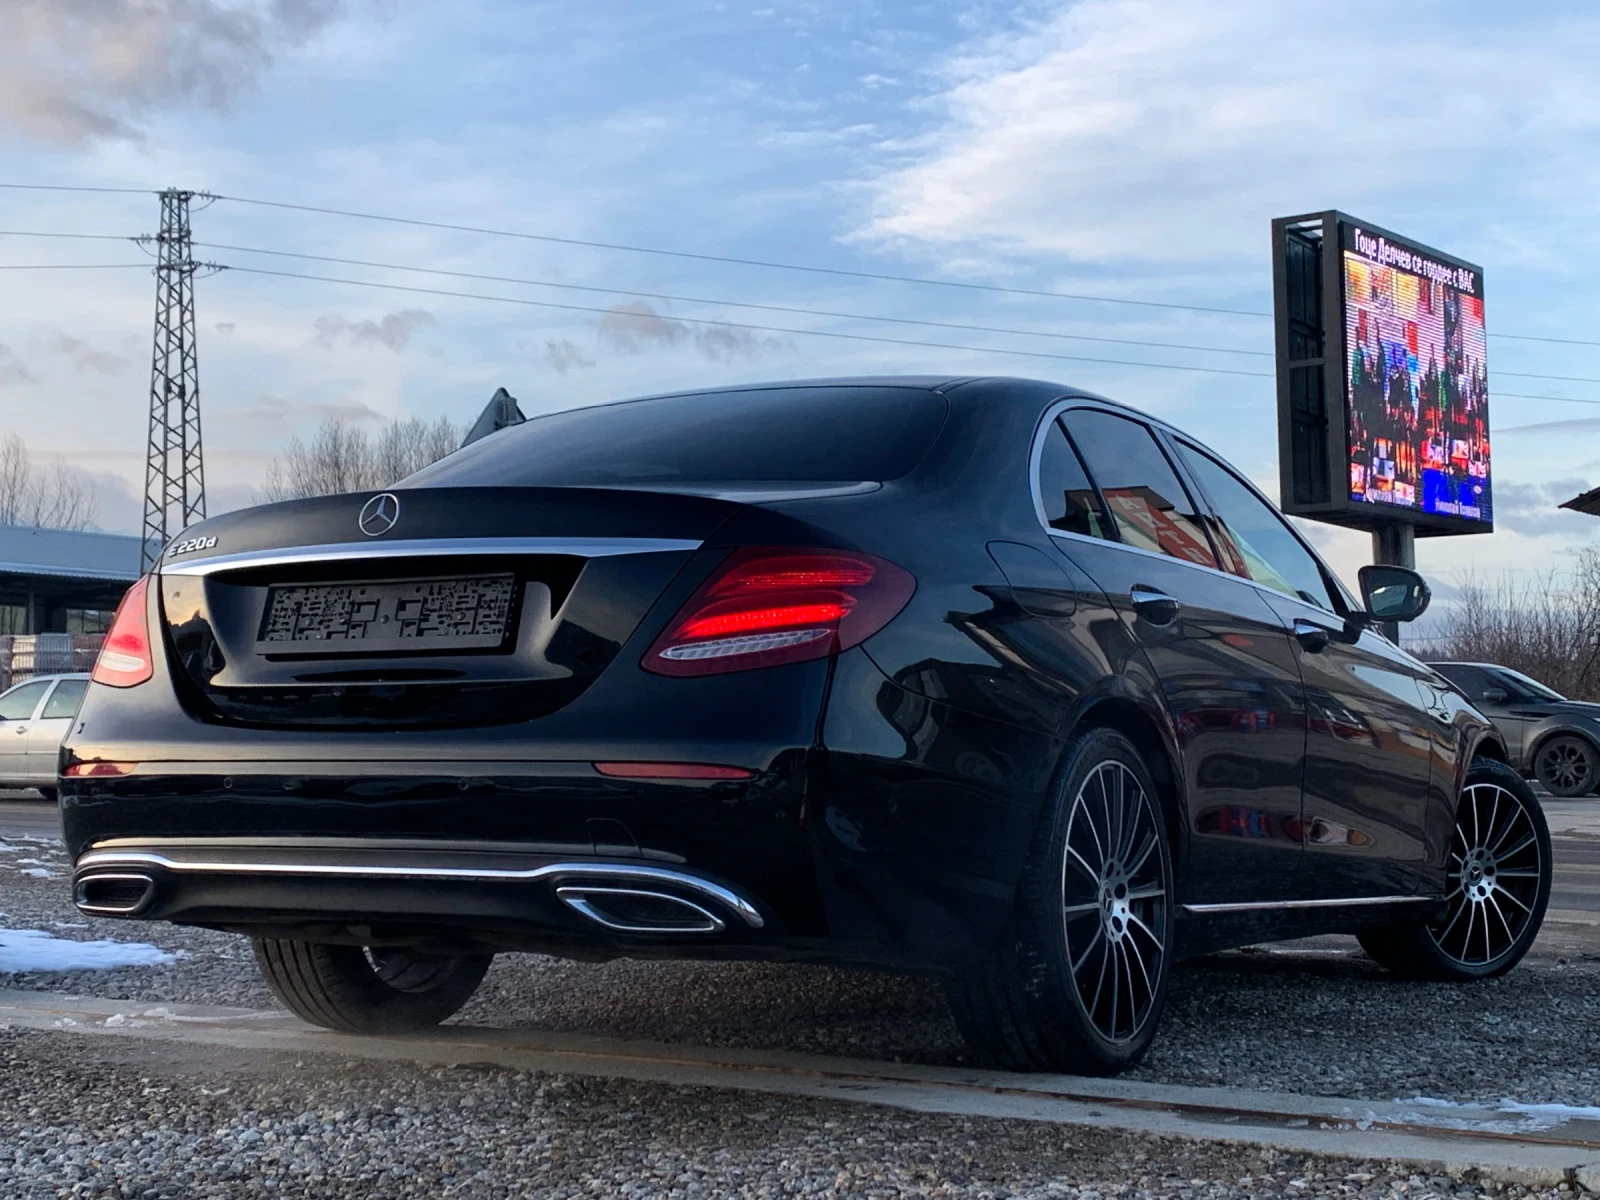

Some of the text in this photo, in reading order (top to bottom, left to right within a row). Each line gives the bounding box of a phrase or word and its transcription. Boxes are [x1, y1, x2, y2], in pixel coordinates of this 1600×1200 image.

[1355, 228, 1377, 260] Гоце
[1378, 237, 1411, 270] Делчев
[1412, 255, 1422, 274] се
[1423, 260, 1452, 286] гордее
[167, 536, 218, 557] E220d
